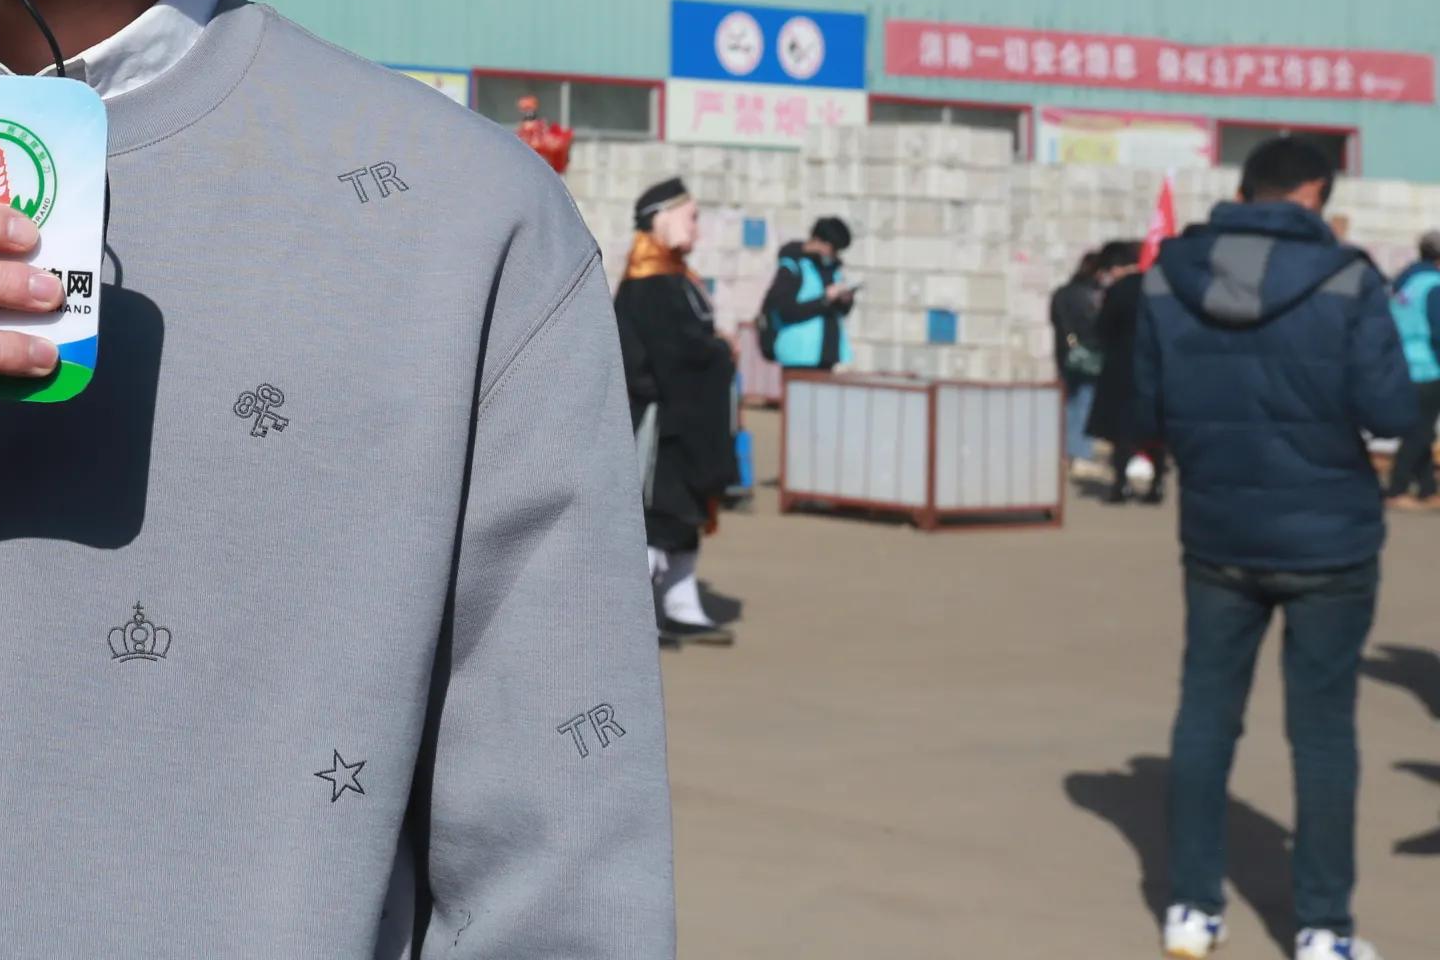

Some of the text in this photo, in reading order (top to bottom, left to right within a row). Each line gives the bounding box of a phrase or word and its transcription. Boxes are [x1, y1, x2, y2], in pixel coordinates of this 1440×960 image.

[692, 91, 847, 136] 严禁烟火
[337, 160, 410, 204] TR
[556, 703, 627, 759] TR
